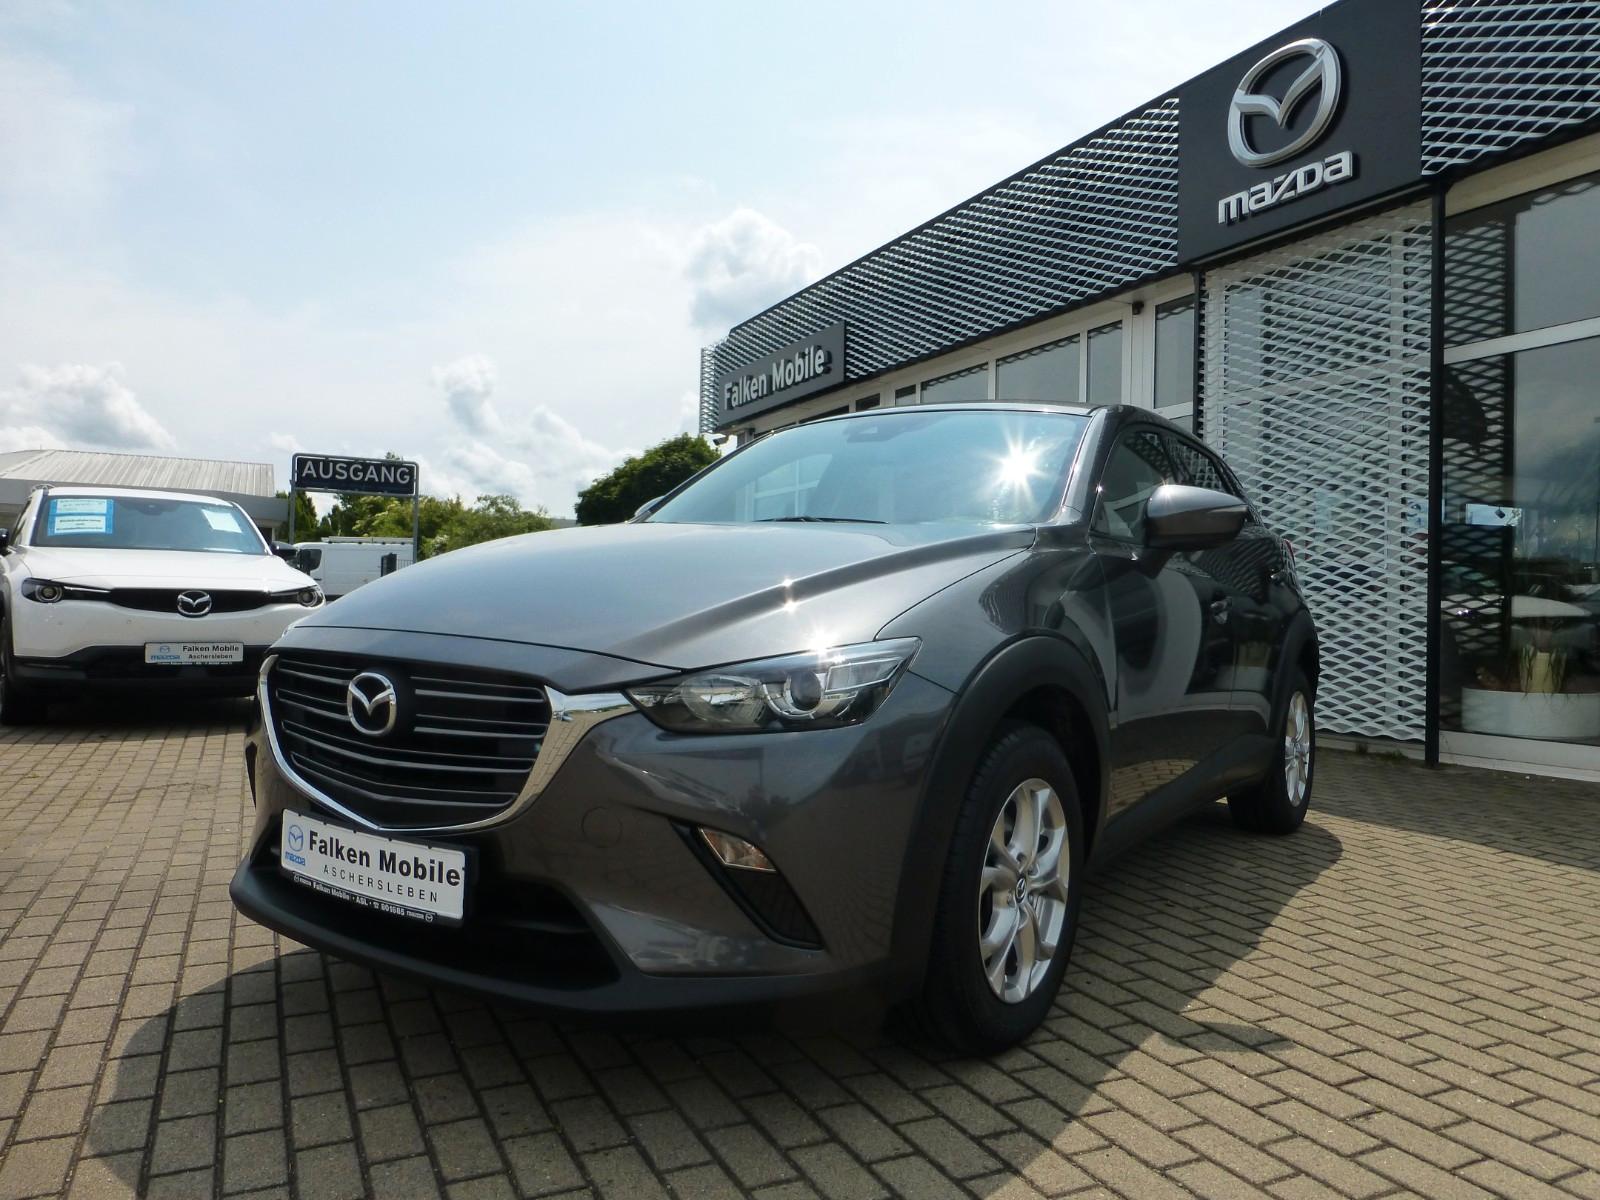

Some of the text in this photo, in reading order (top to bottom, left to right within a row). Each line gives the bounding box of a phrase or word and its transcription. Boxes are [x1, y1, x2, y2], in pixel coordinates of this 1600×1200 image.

[724, 345, 826, 411] Falken Mobile
[301, 460, 411, 485] AUSGANG
[309, 830, 461, 887] Falken Mobile
[323, 864, 438, 903] ASCHERSLEBEN
